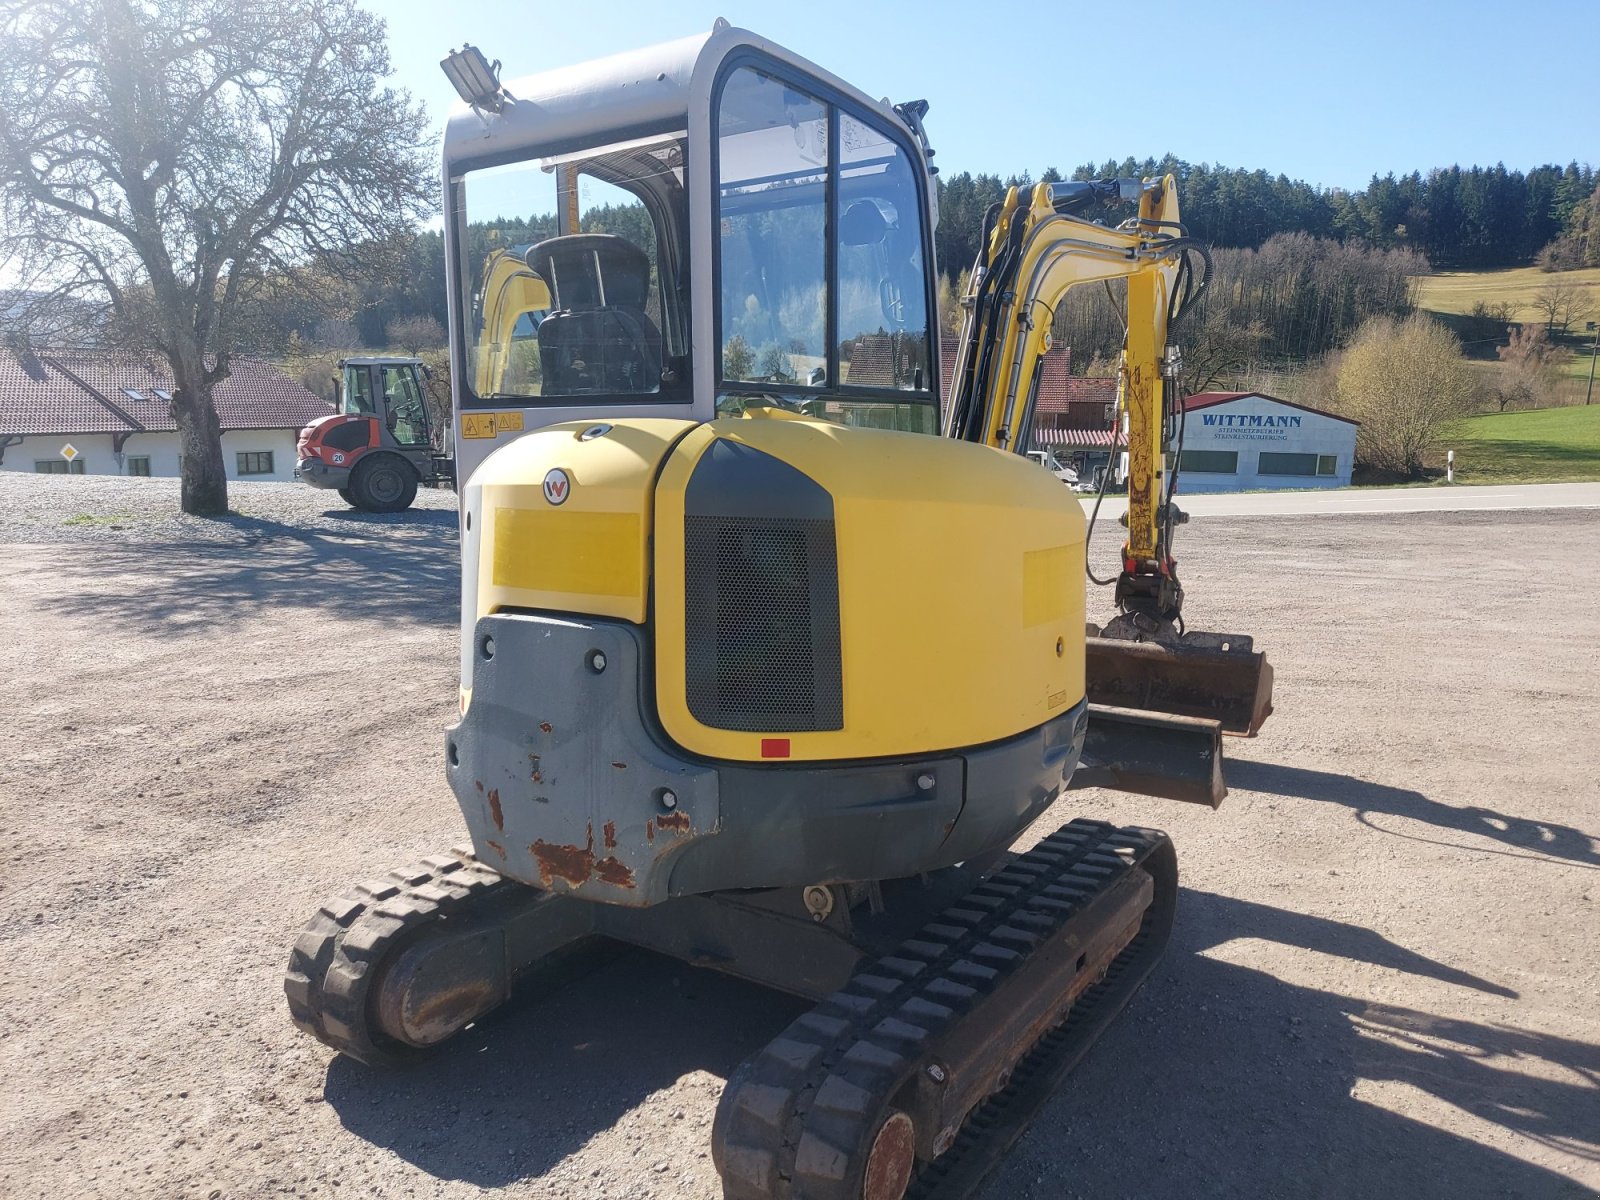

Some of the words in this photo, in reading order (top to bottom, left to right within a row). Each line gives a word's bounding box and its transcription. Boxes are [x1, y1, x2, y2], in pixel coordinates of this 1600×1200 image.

[1202, 414, 1303, 428] WITTMANN
[1218, 427, 1284, 435] STEINMETZBETRIEB
[334, 454, 343, 462] 20
